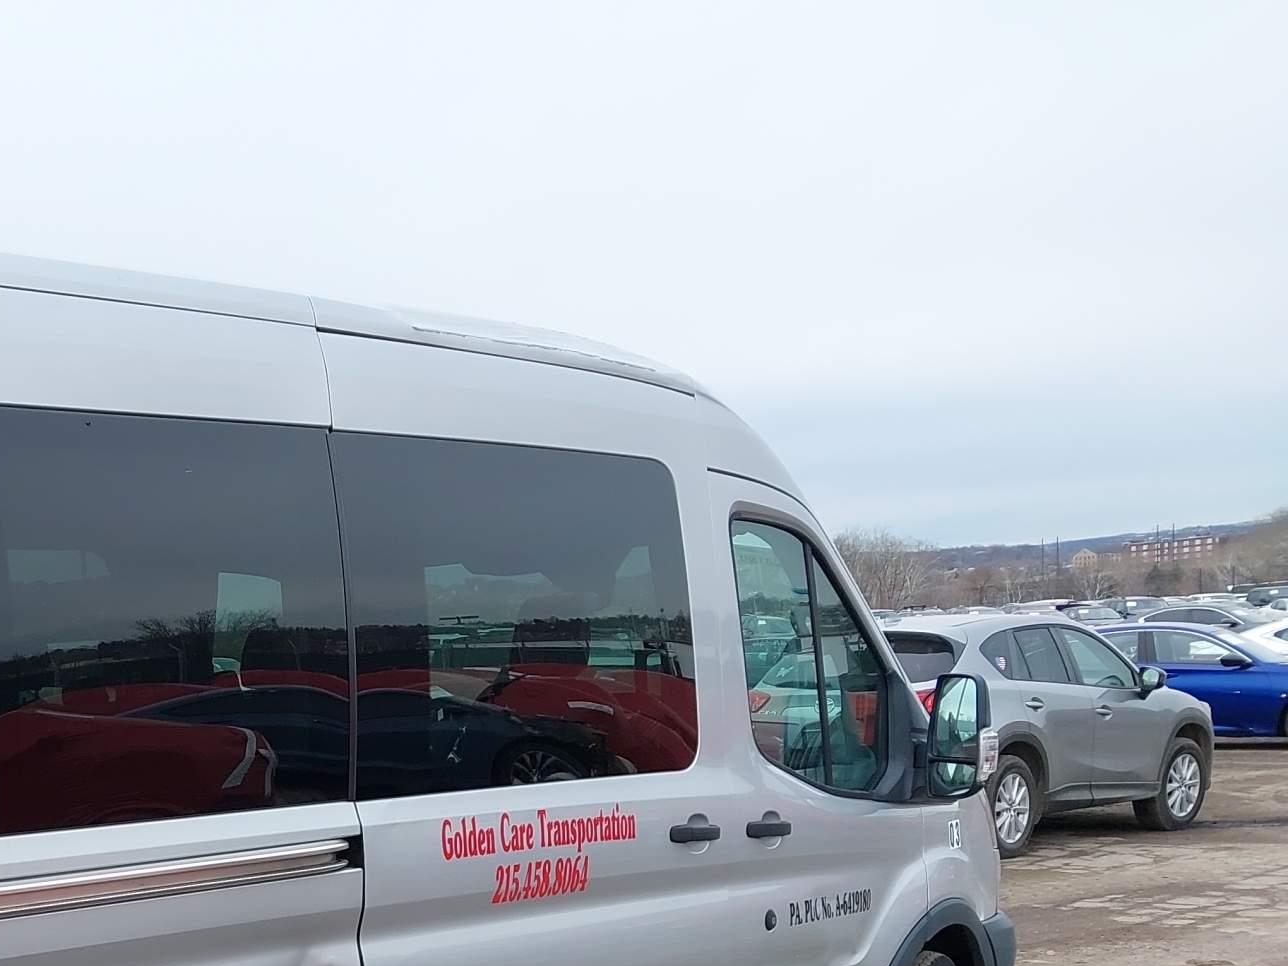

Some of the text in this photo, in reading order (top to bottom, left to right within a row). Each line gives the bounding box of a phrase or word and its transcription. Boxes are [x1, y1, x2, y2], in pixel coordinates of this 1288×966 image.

[441, 802, 637, 861] Golden Care Transportation
[949, 821, 960, 848] 03
[492, 855, 590, 905] 215.458.8064
[821, 896, 834, 920] No.
[836, 888, 872, 917] A-6419180
